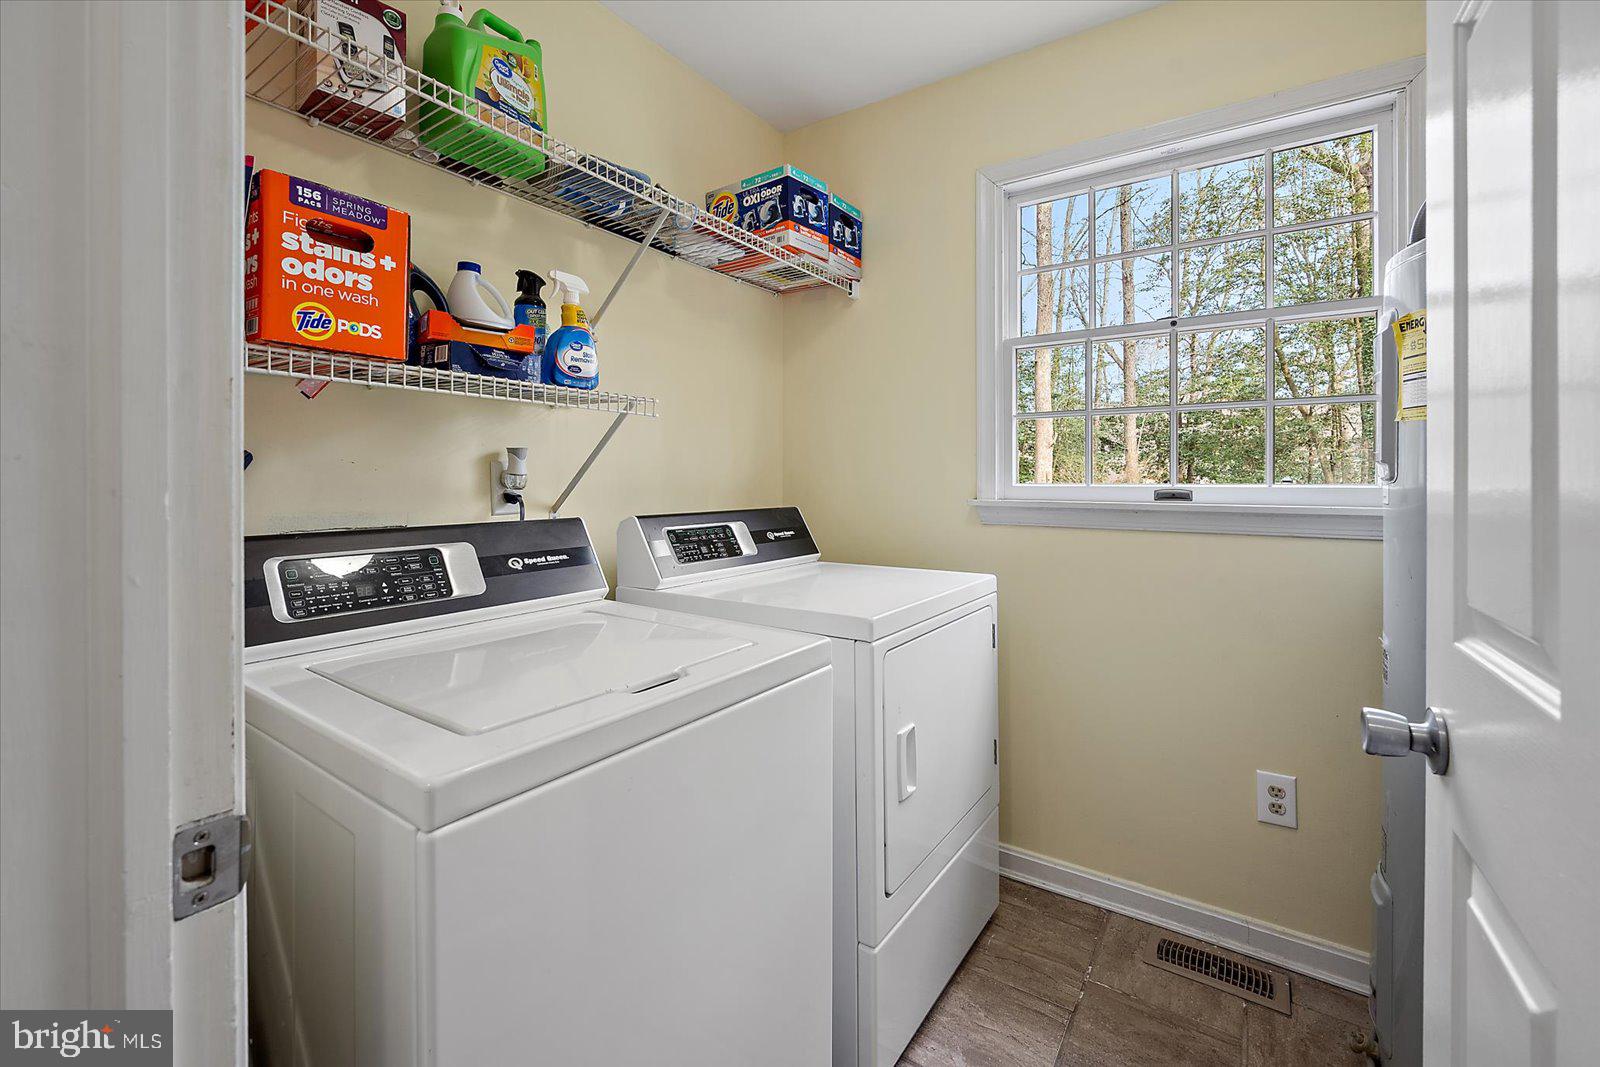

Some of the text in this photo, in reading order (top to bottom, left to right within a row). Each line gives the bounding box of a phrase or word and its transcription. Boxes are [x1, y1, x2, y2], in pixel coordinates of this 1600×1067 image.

[296, 185, 322, 201] 156
[298, 196, 322, 208] PACS
[743, 192, 761, 207] OXI
[761, 185, 783, 198] ODOR
[332, 197, 372, 215] SPRING
[713, 199, 735, 219] Tide
[281, 231, 377, 270] stains
[379, 254, 396, 272] +
[281, 256, 373, 291] odors
[281, 274, 380, 307] in one wash
[295, 309, 332, 332] Tide
[337, 319, 383, 339] PODS
[523, 556, 546, 564] Speed
